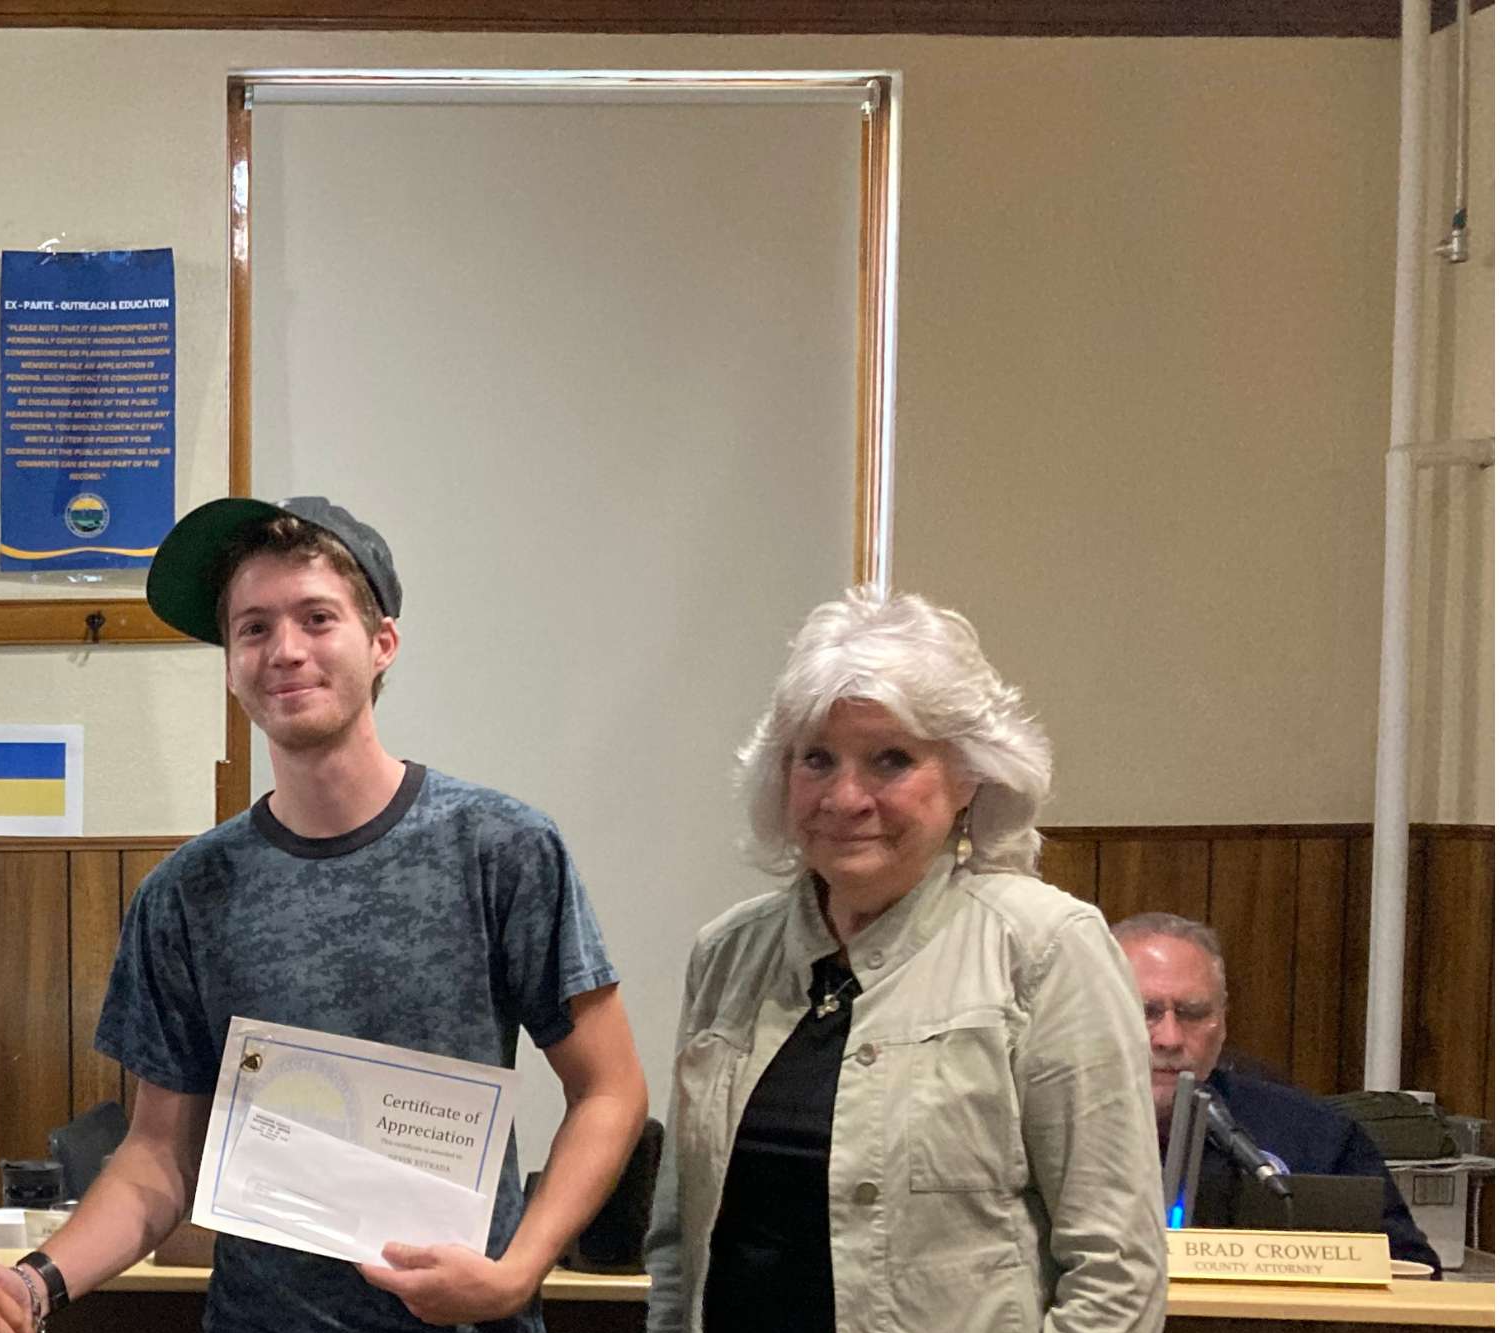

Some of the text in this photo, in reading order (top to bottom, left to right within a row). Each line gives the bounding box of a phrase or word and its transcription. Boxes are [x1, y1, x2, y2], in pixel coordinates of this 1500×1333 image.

[4, 300, 17, 310] EX
[24, 301, 54, 310] PARTE
[61, 301, 109, 310] OUTREACH
[119, 299, 169, 309] EDUCATION
[382, 1093, 483, 1125] Certificate of
[376, 1116, 475, 1148] Appreciation
[1186, 1241, 1361, 1262] BRAD CROWELL
[1194, 1261, 1323, 1275] COUNTY ATTORNEY
